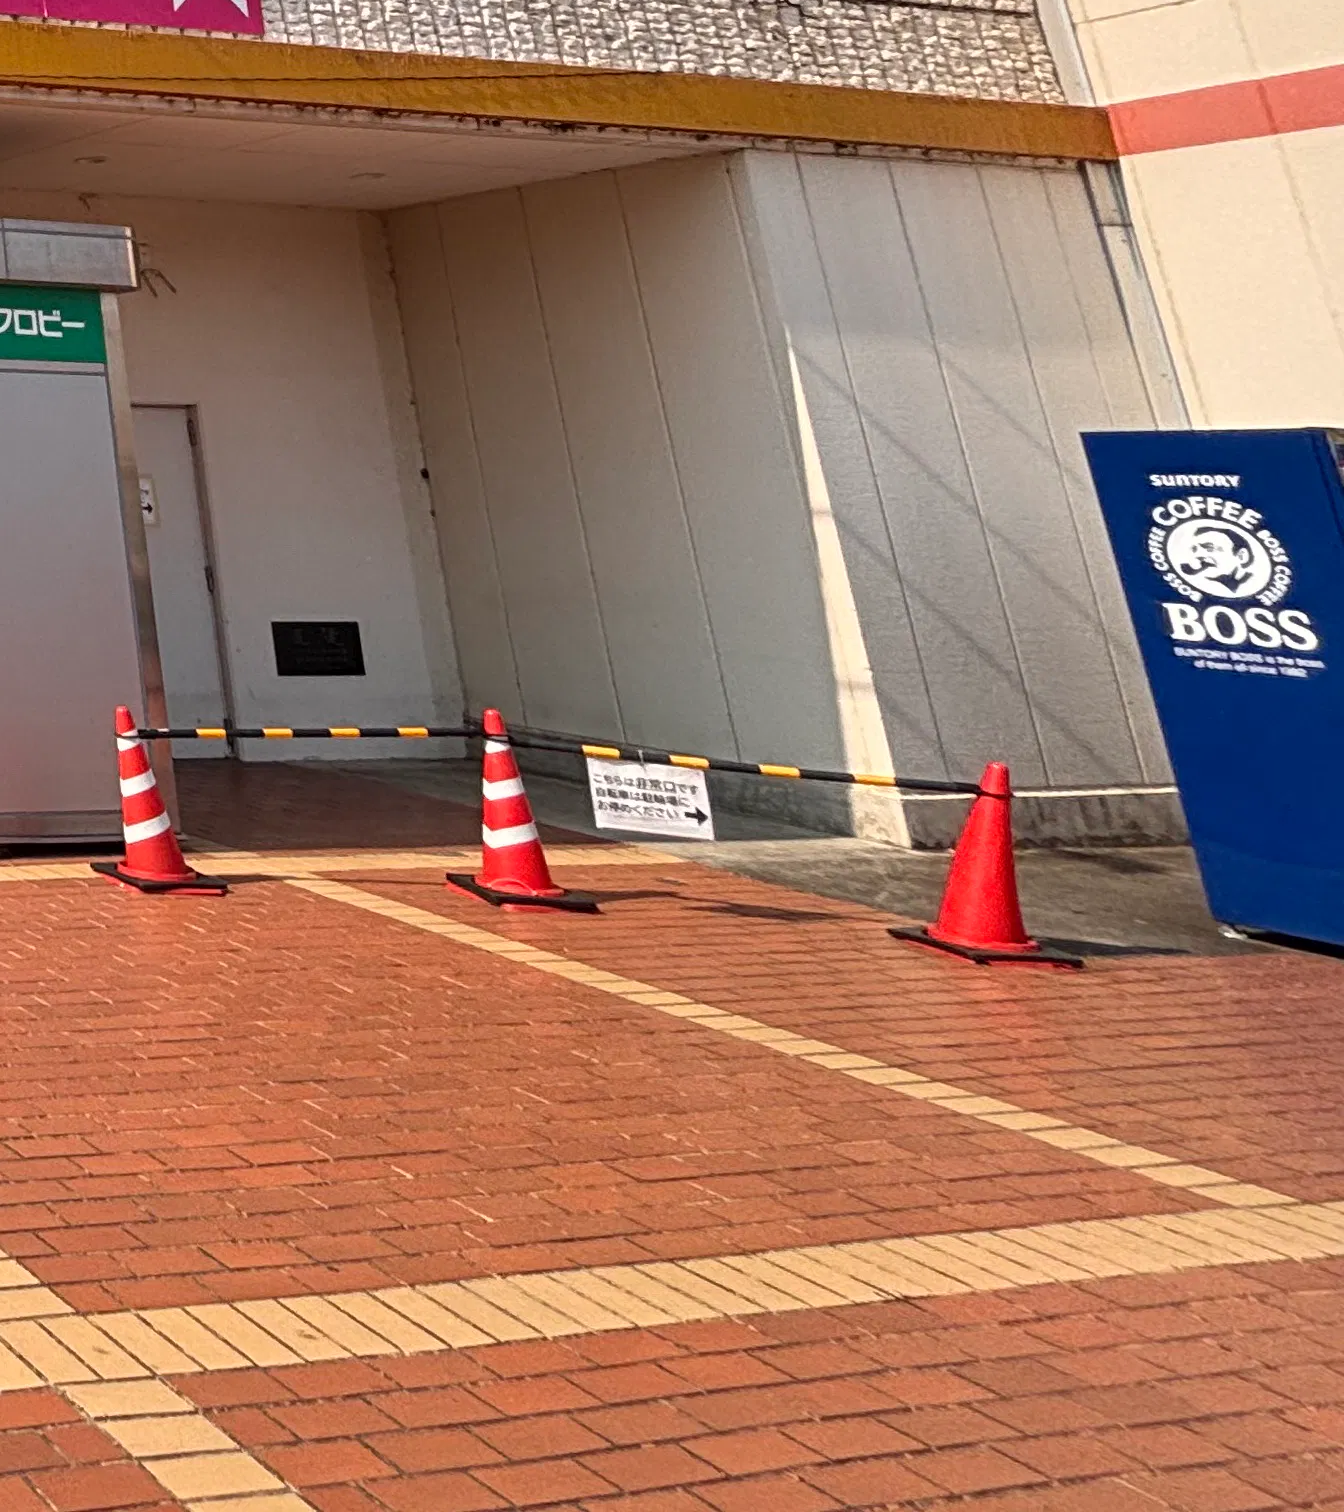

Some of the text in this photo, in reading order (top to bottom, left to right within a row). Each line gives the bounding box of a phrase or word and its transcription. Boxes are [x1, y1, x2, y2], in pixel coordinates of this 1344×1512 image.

[1152, 496, 1262, 530] COFFEE
[1162, 602, 1318, 651] BOSS
[593, 774, 698, 795] こちらは非常口です
